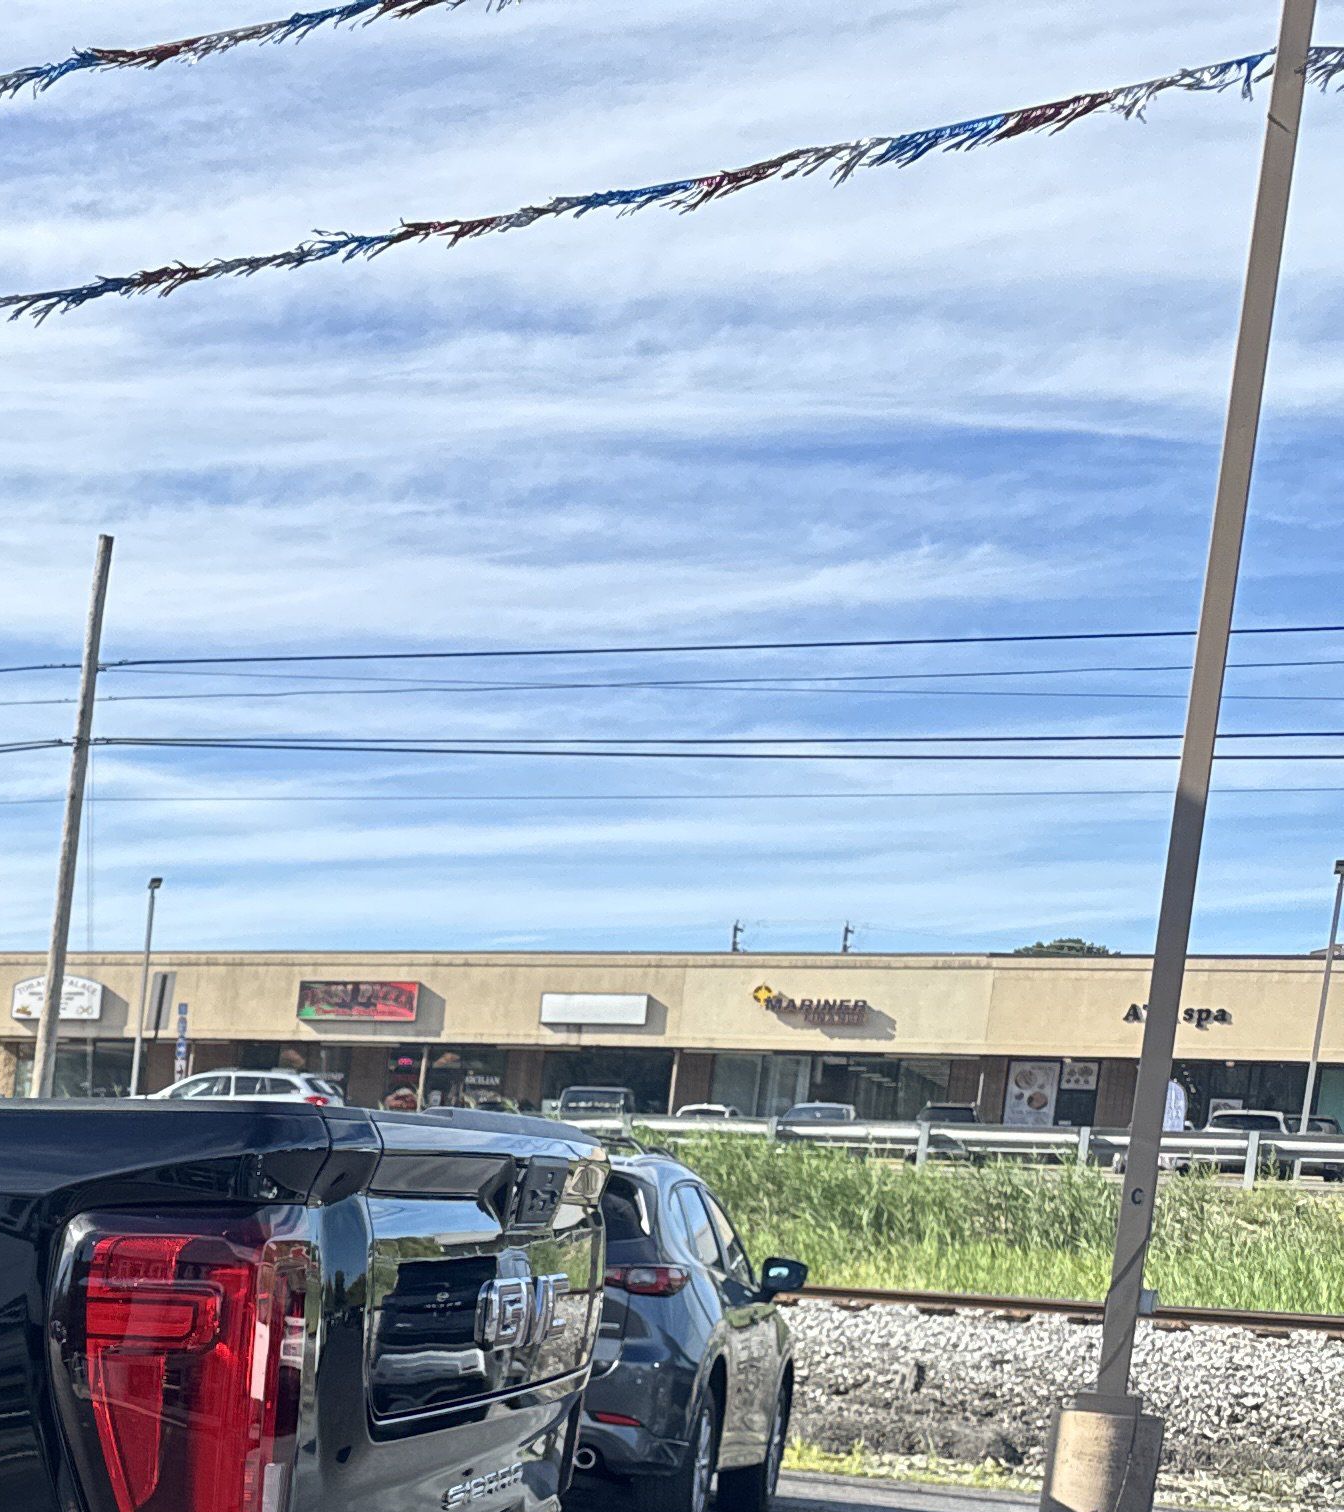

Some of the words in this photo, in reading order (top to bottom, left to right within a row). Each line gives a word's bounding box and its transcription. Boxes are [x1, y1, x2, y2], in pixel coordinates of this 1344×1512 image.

[356, 983, 415, 1013] PIZZA
[765, 997, 868, 1013] MARINER
[1182, 1007, 1231, 1029] spa
[474, 1273, 570, 1351] GMC
[441, 1461, 523, 1511] SIERRA
